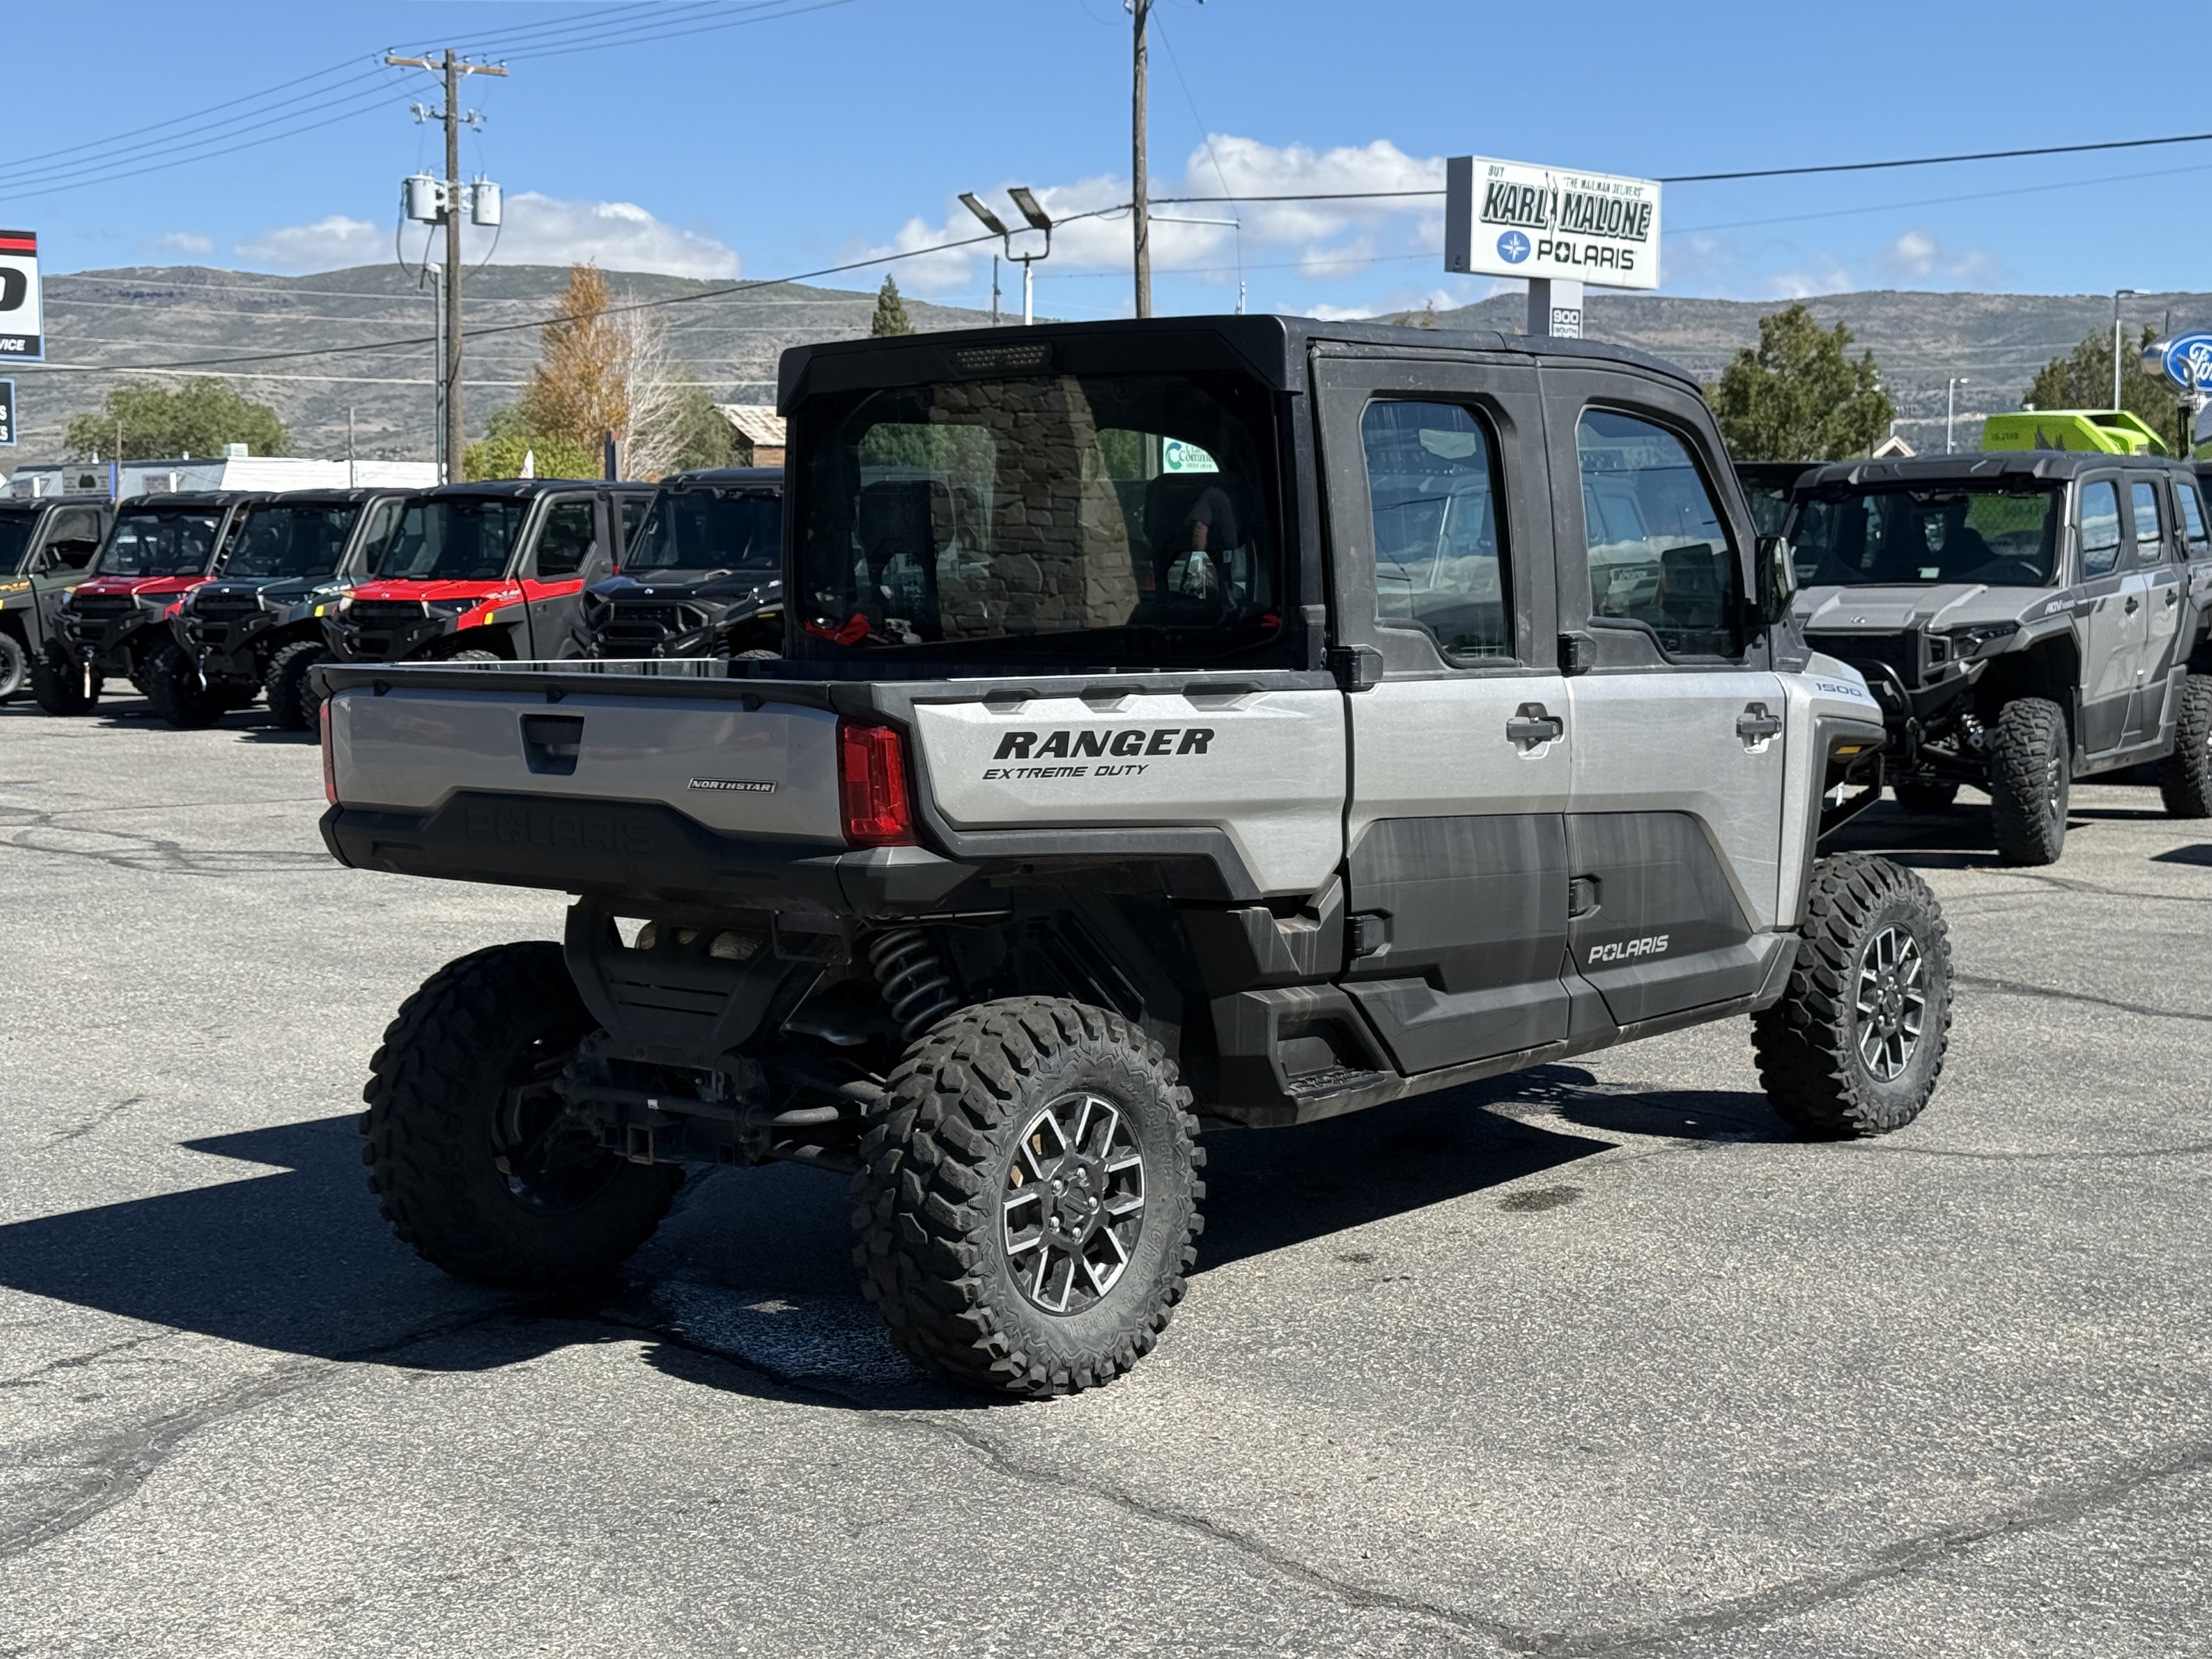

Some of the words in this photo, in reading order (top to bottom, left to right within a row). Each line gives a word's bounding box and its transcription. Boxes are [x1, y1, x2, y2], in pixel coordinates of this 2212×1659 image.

[1488, 165, 1504, 177] BUY
[1480, 179, 1548, 229] KARL
[1558, 190, 1652, 242] MALONE
[1537, 239, 1635, 270] POLARIS
[1815, 682, 1863, 697] 1500
[992, 728, 1215, 760] RANGER
[691, 780, 771, 792] NORTHSTAR
[981, 766, 1089, 780] EXTREME
[1094, 764, 1150, 777] DUTY
[465, 807, 654, 854] POLARIS
[1587, 934, 1670, 964] POLARIS
